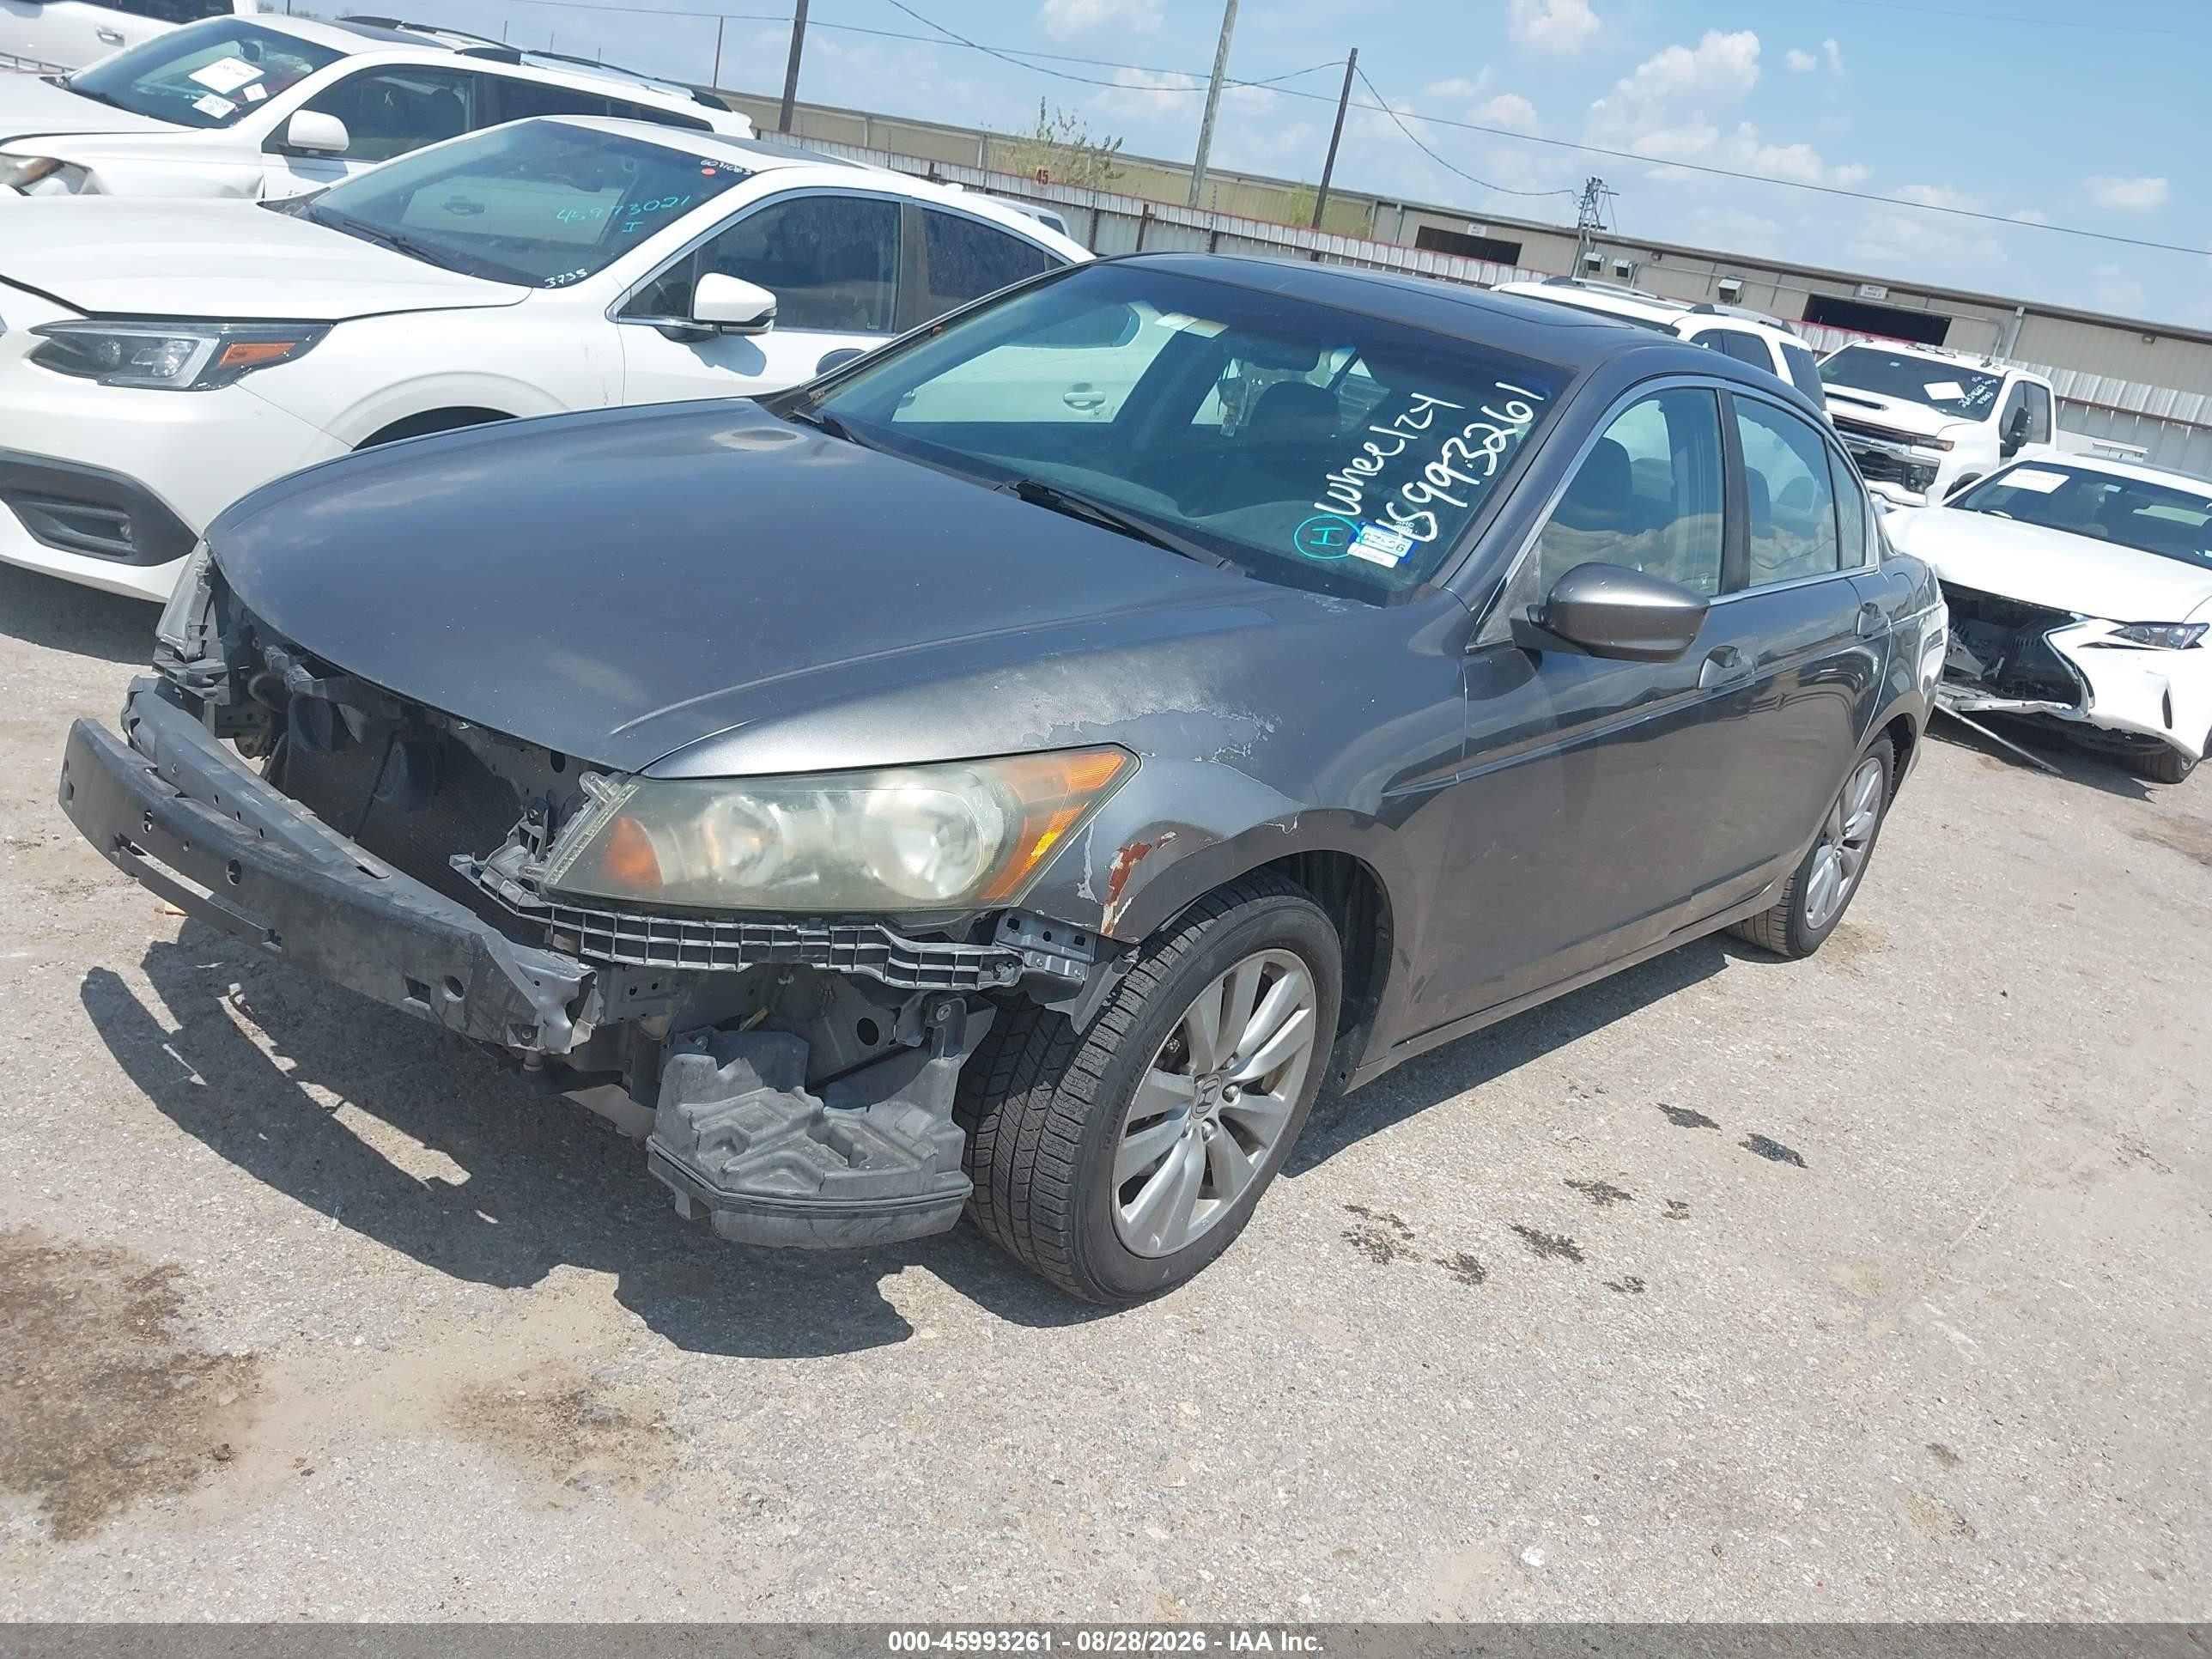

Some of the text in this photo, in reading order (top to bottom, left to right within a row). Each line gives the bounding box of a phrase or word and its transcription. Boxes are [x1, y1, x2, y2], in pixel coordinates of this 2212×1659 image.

[1036, 169, 1048, 185] 45
[544, 268, 588, 289] 3735
[1314, 392, 1466, 516] Wheelzy
